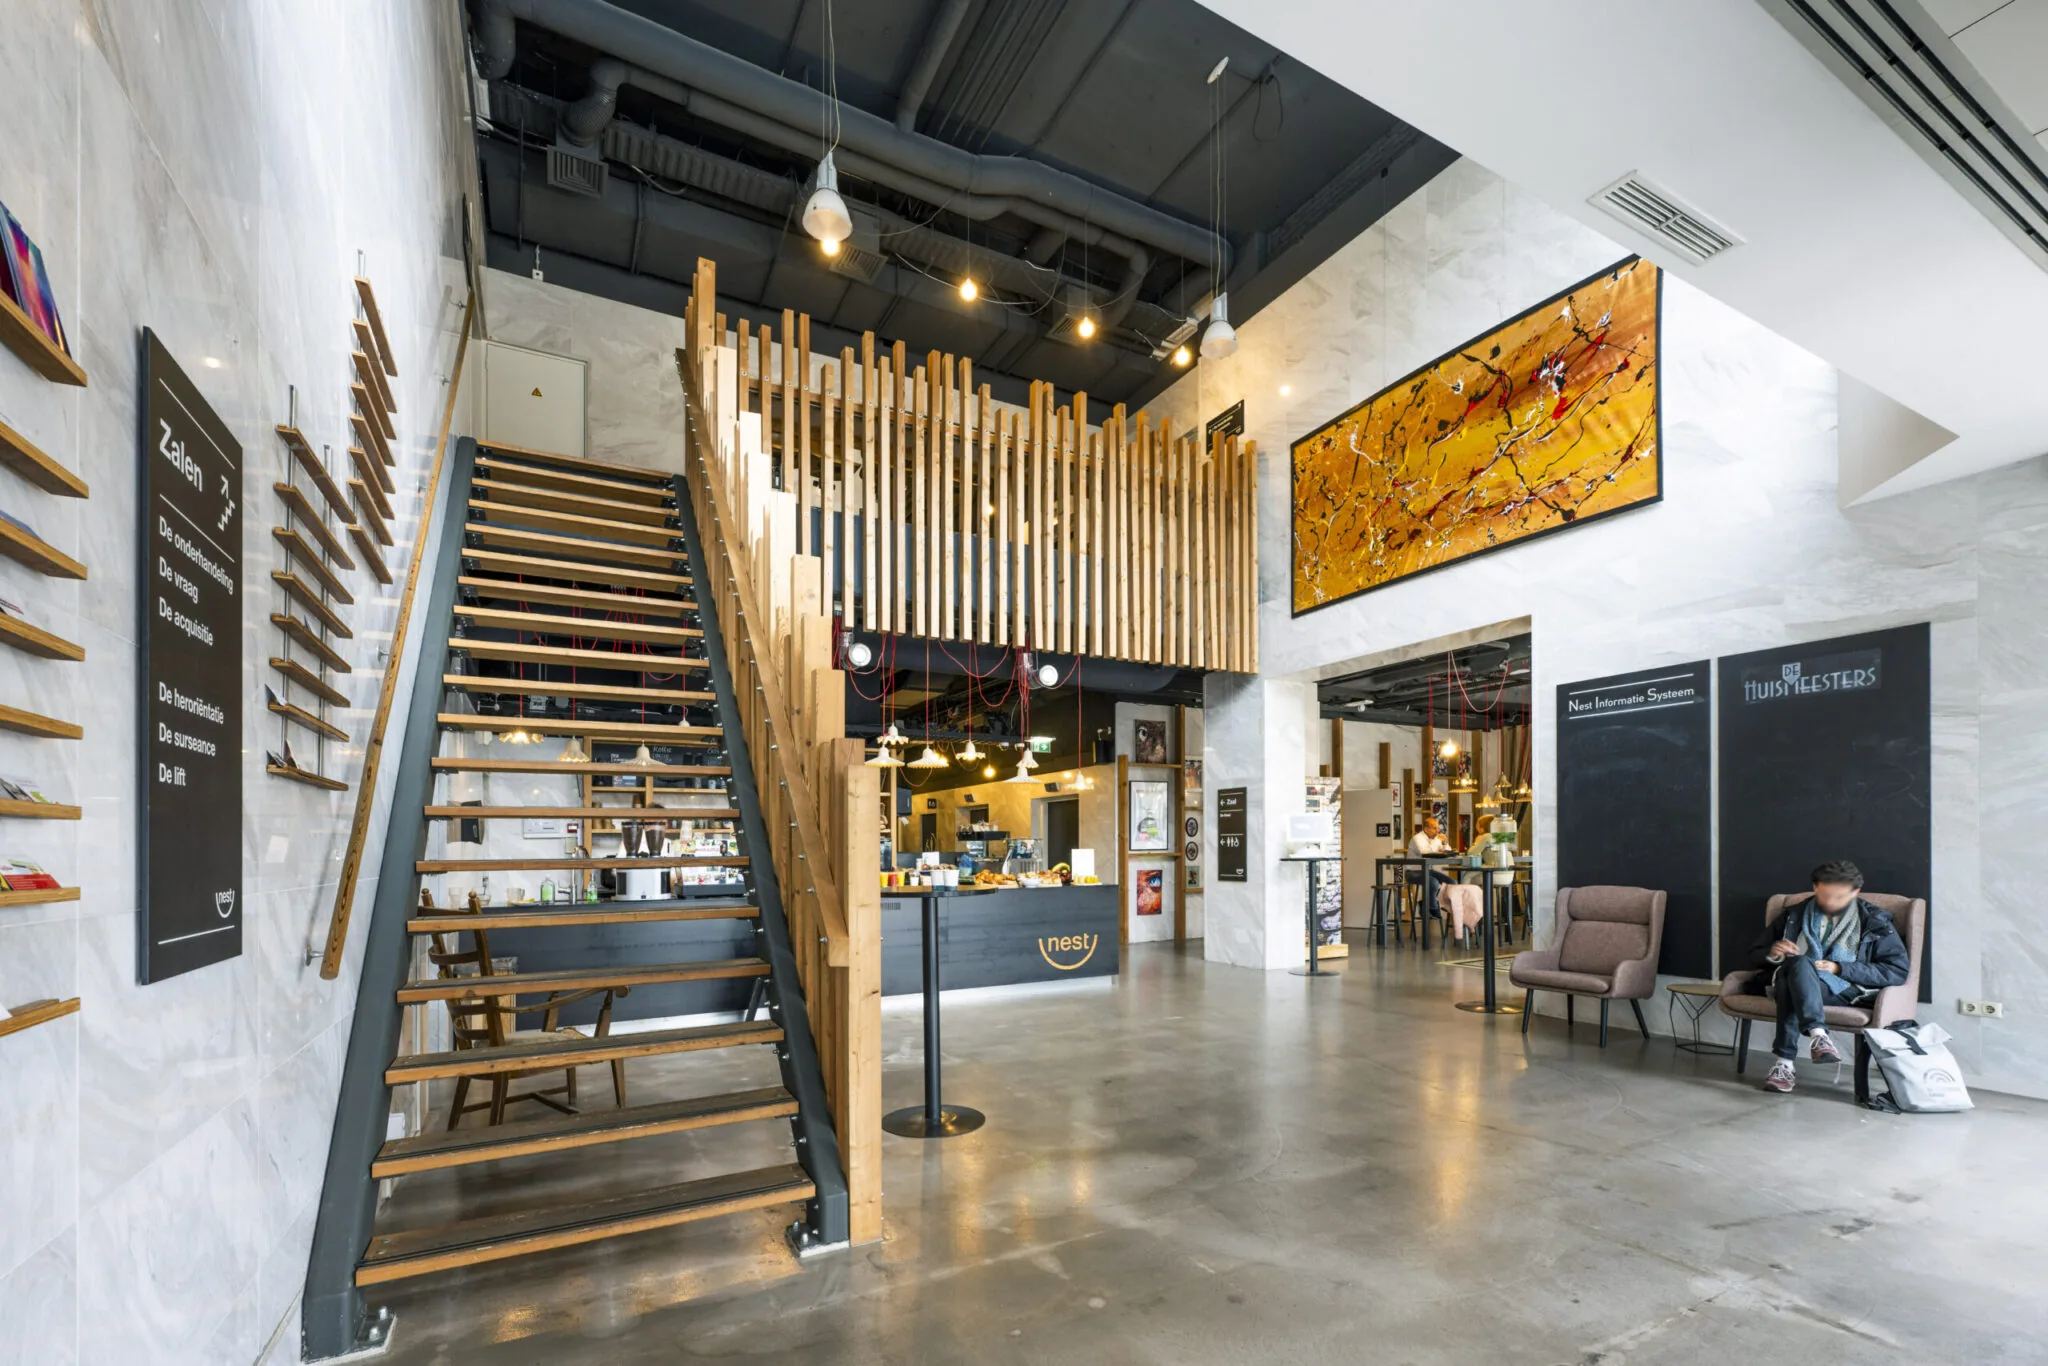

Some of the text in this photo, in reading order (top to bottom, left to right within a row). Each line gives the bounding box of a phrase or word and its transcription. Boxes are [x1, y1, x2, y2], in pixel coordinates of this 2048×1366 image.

[160, 418, 203, 492] Zalen
[160, 515, 234, 595] De onderhandeling
[160, 556, 199, 604] De vraag
[160, 596, 214, 646] De acquisitie
[1784, 664, 1799, 676] DE
[159, 681, 224, 724] De heroriëntatie
[1568, 688, 1695, 712] Nest Informatie Systeem
[159, 722, 216, 756] De surseance
[159, 763, 186, 786] De lift
[218, 887, 233, 904] nest
[1047, 932, 1090, 953] nest
